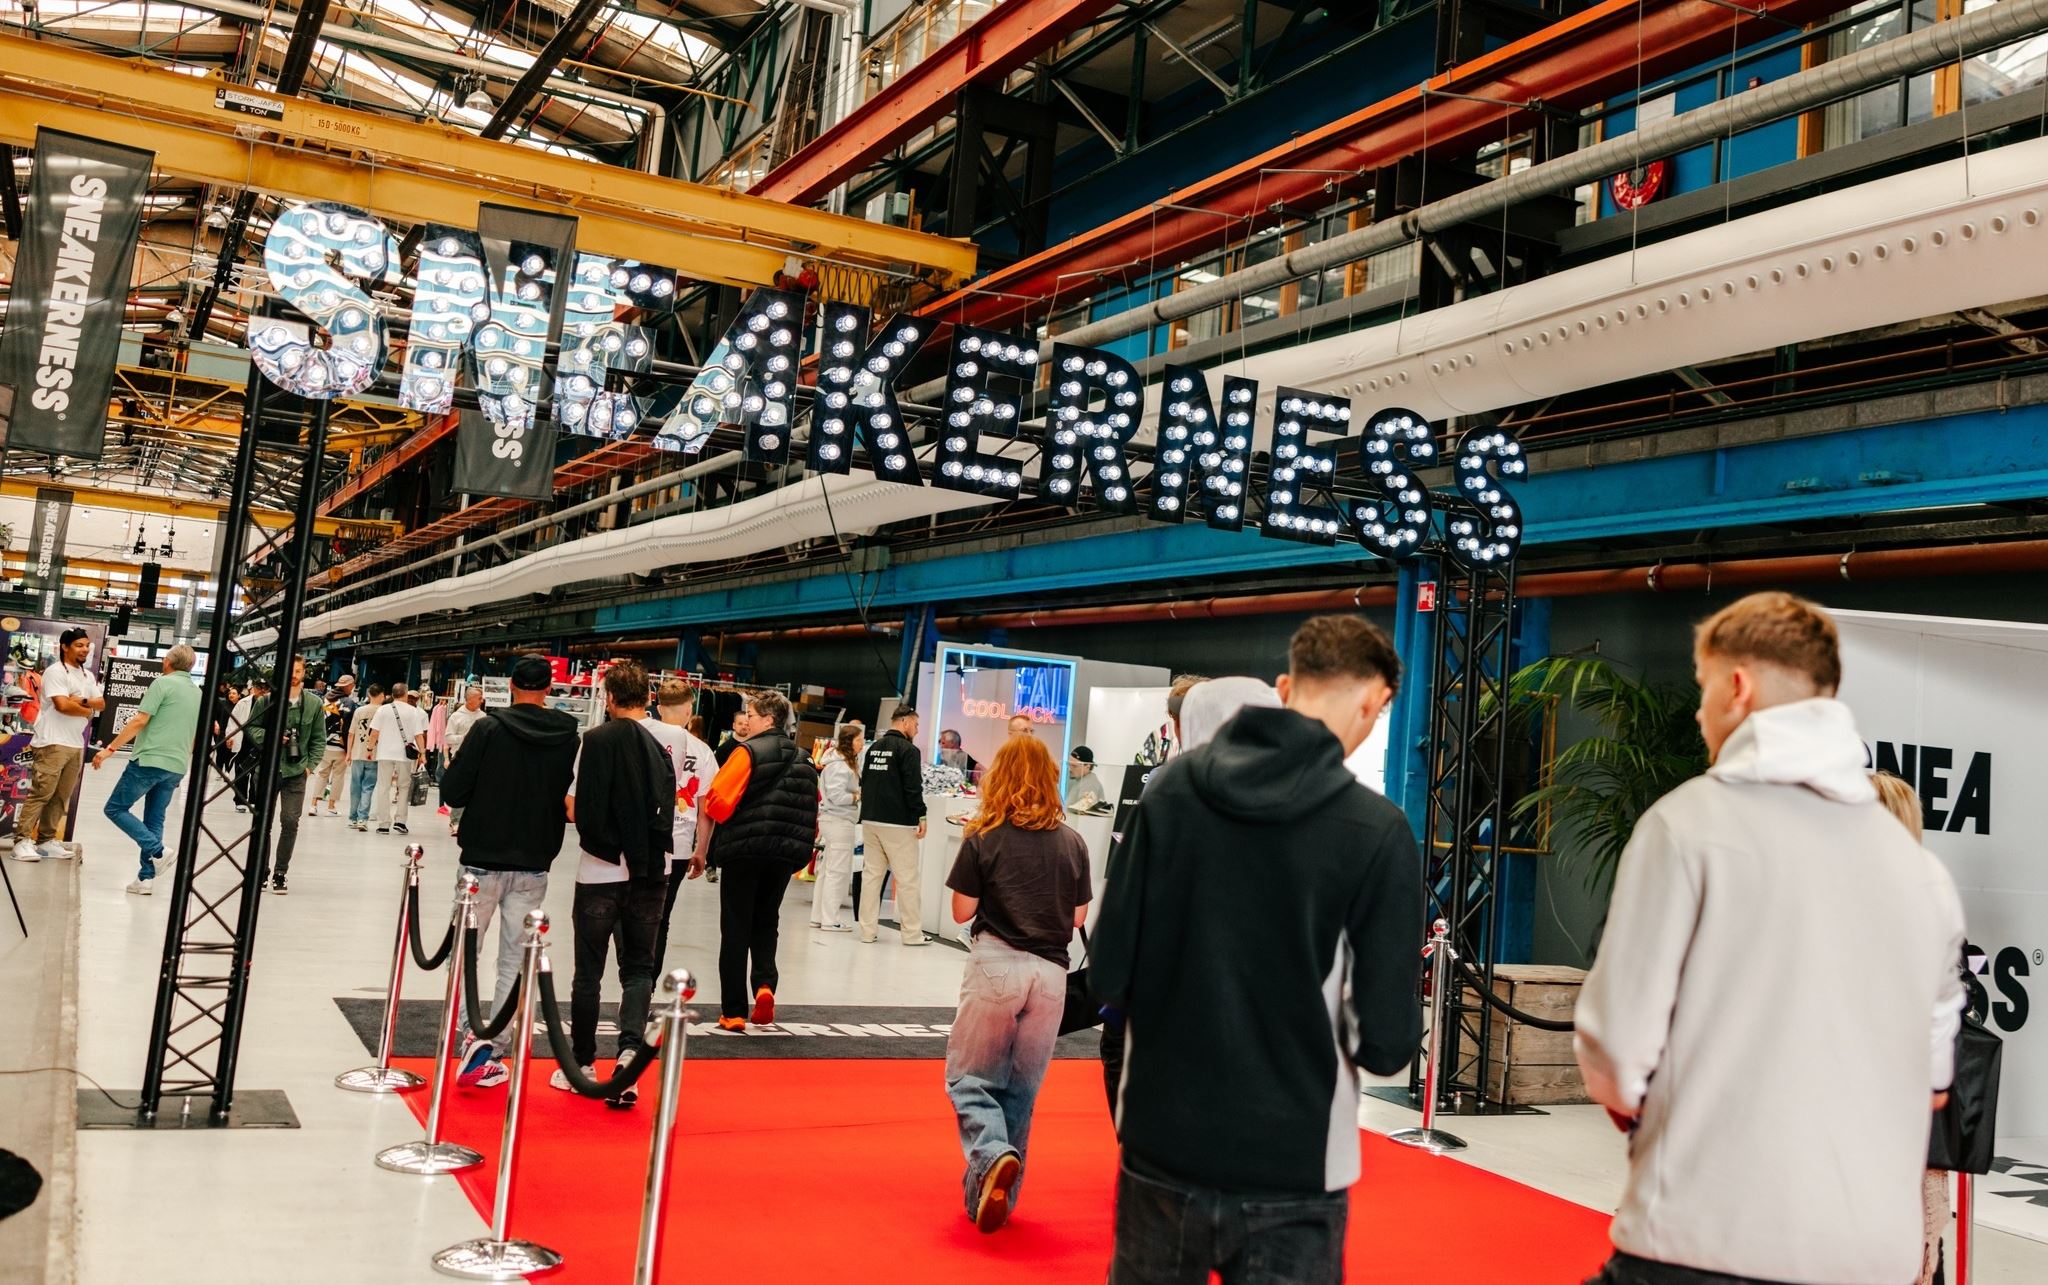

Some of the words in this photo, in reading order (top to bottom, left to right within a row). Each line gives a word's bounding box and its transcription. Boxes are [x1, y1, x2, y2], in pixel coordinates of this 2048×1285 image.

[250, 107, 268, 116] TON
[249, 201, 1528, 571] SNEAKERNESS
[112, 662, 141, 670] BECOME
[963, 700, 1011, 720] COOL
